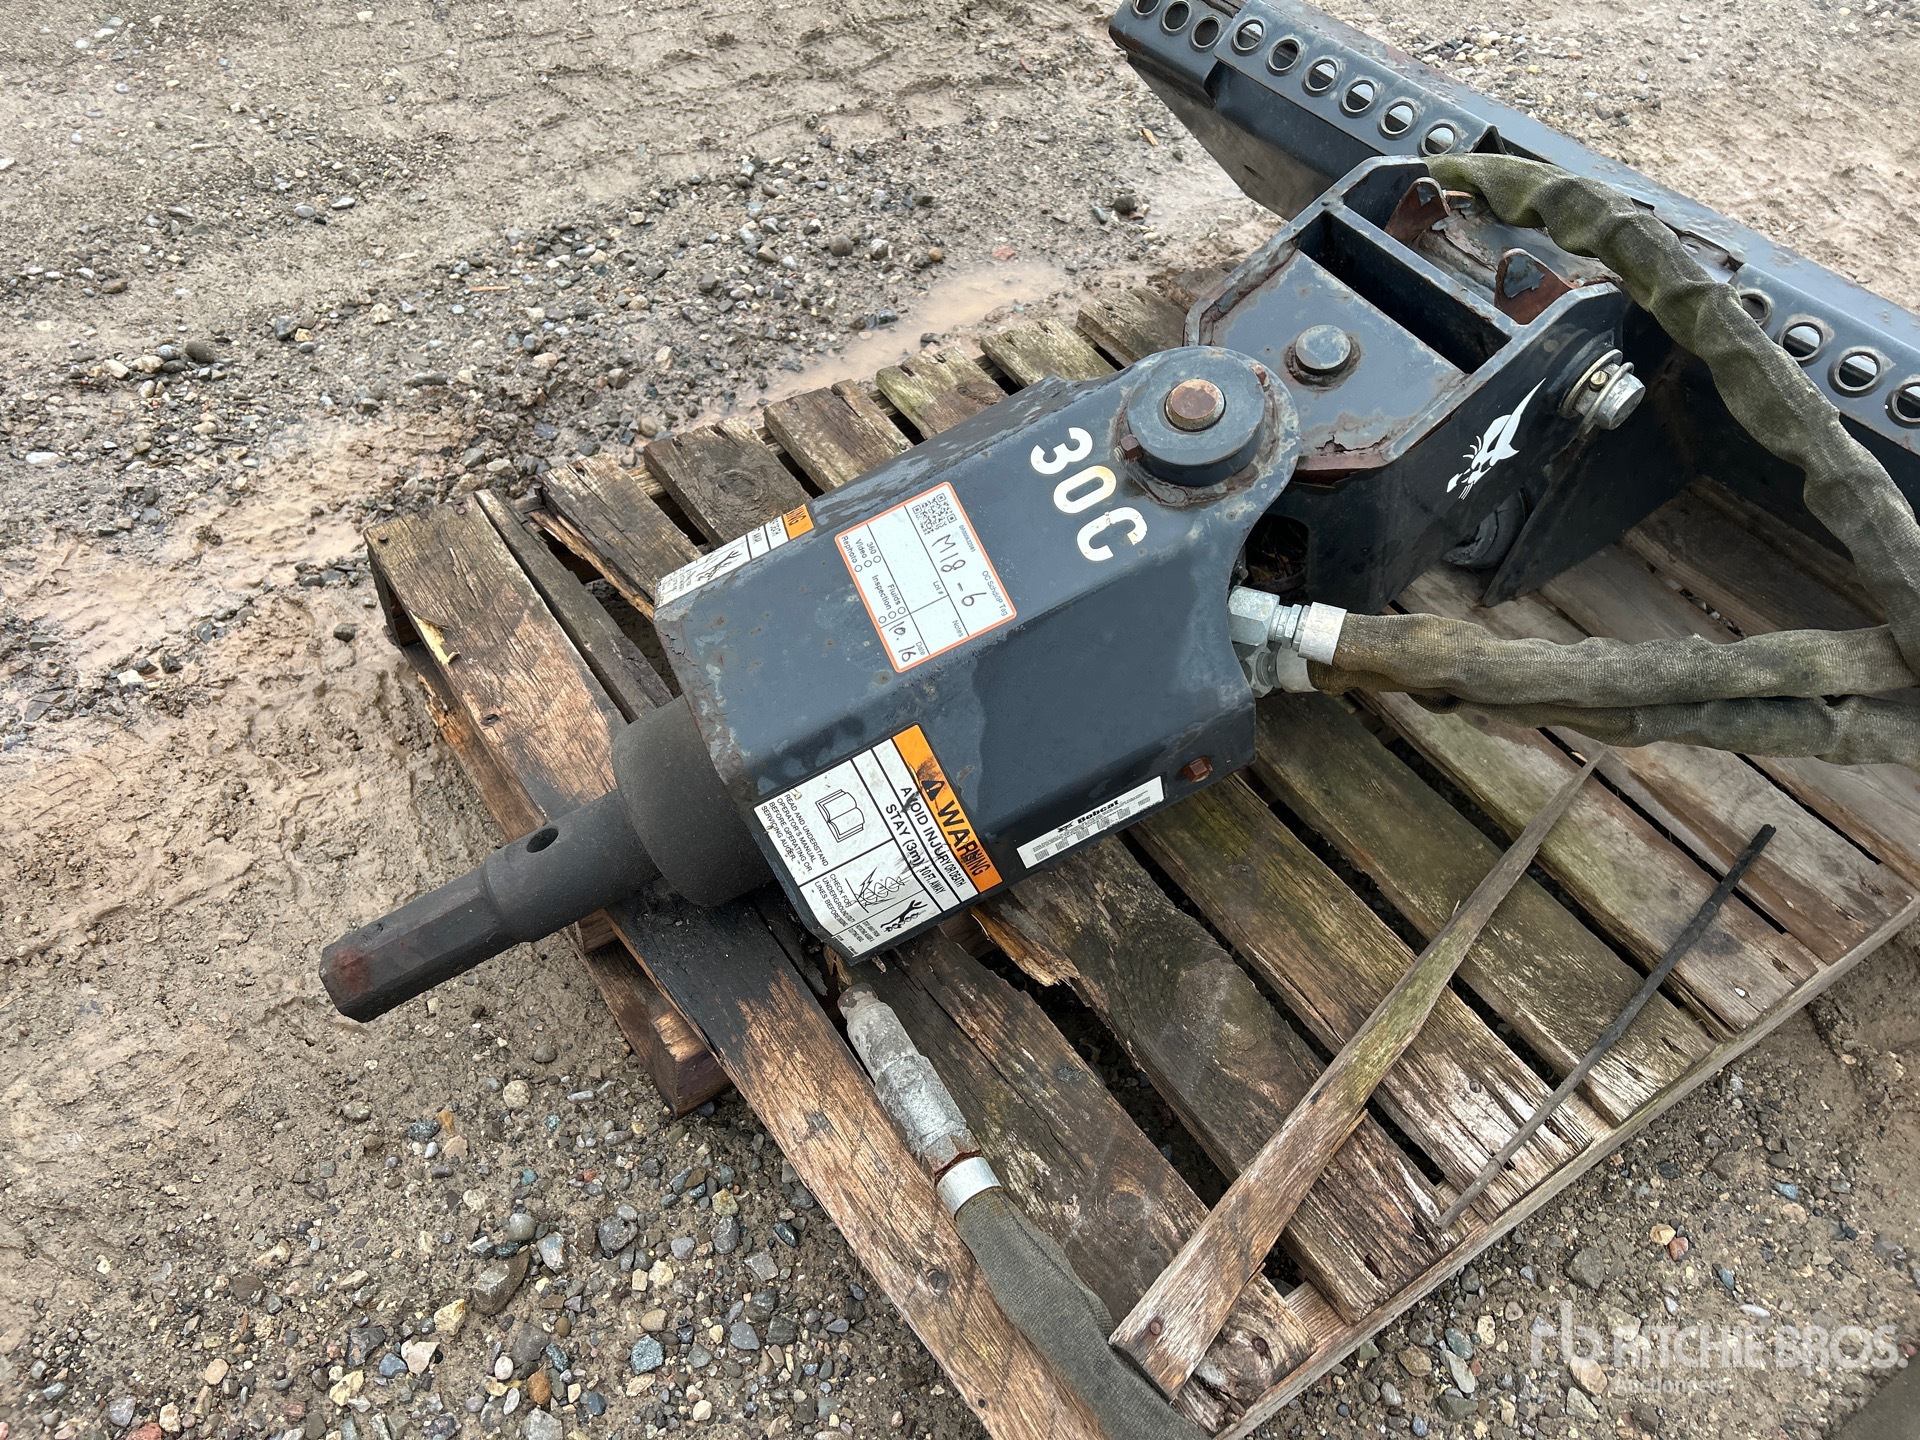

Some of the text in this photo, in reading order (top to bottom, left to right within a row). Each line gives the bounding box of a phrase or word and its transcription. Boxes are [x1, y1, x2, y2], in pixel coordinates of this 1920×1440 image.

[1030, 427, 1147, 561] 30C
[840, 535, 858, 563] Rephoto
[855, 539, 868, 559] Video
[866, 541, 876, 554] 360
[870, 574, 892, 610] Inspection
[887, 583, 901, 605] Fluids
[932, 580, 941, 591] Lot
[981, 569, 991, 581] OC
[998, 602, 1009, 616] Tag
[951, 619, 964, 637] Notes
[915, 640, 925, 655] Date
[783, 793, 829, 866] READ AND UNDERSTAND
[1077, 799, 1119, 823] Bobcat
[760, 805, 796, 861] SERVICING AUGER.
[768, 801, 812, 871] BEFORE OPERATING OR
[776, 797, 816, 863] OPERATOR'S MANUAL
[884, 802, 945, 895] STAY (3m) 10 FT. AWAY
[899, 783, 966, 888] AVOID INJURY OR DEATH
[935, 799, 991, 877] WARNING
[814, 880, 839, 919] LINES BEFORE
[829, 873, 843, 895] CHECK
[841, 894, 851, 907] FOR
